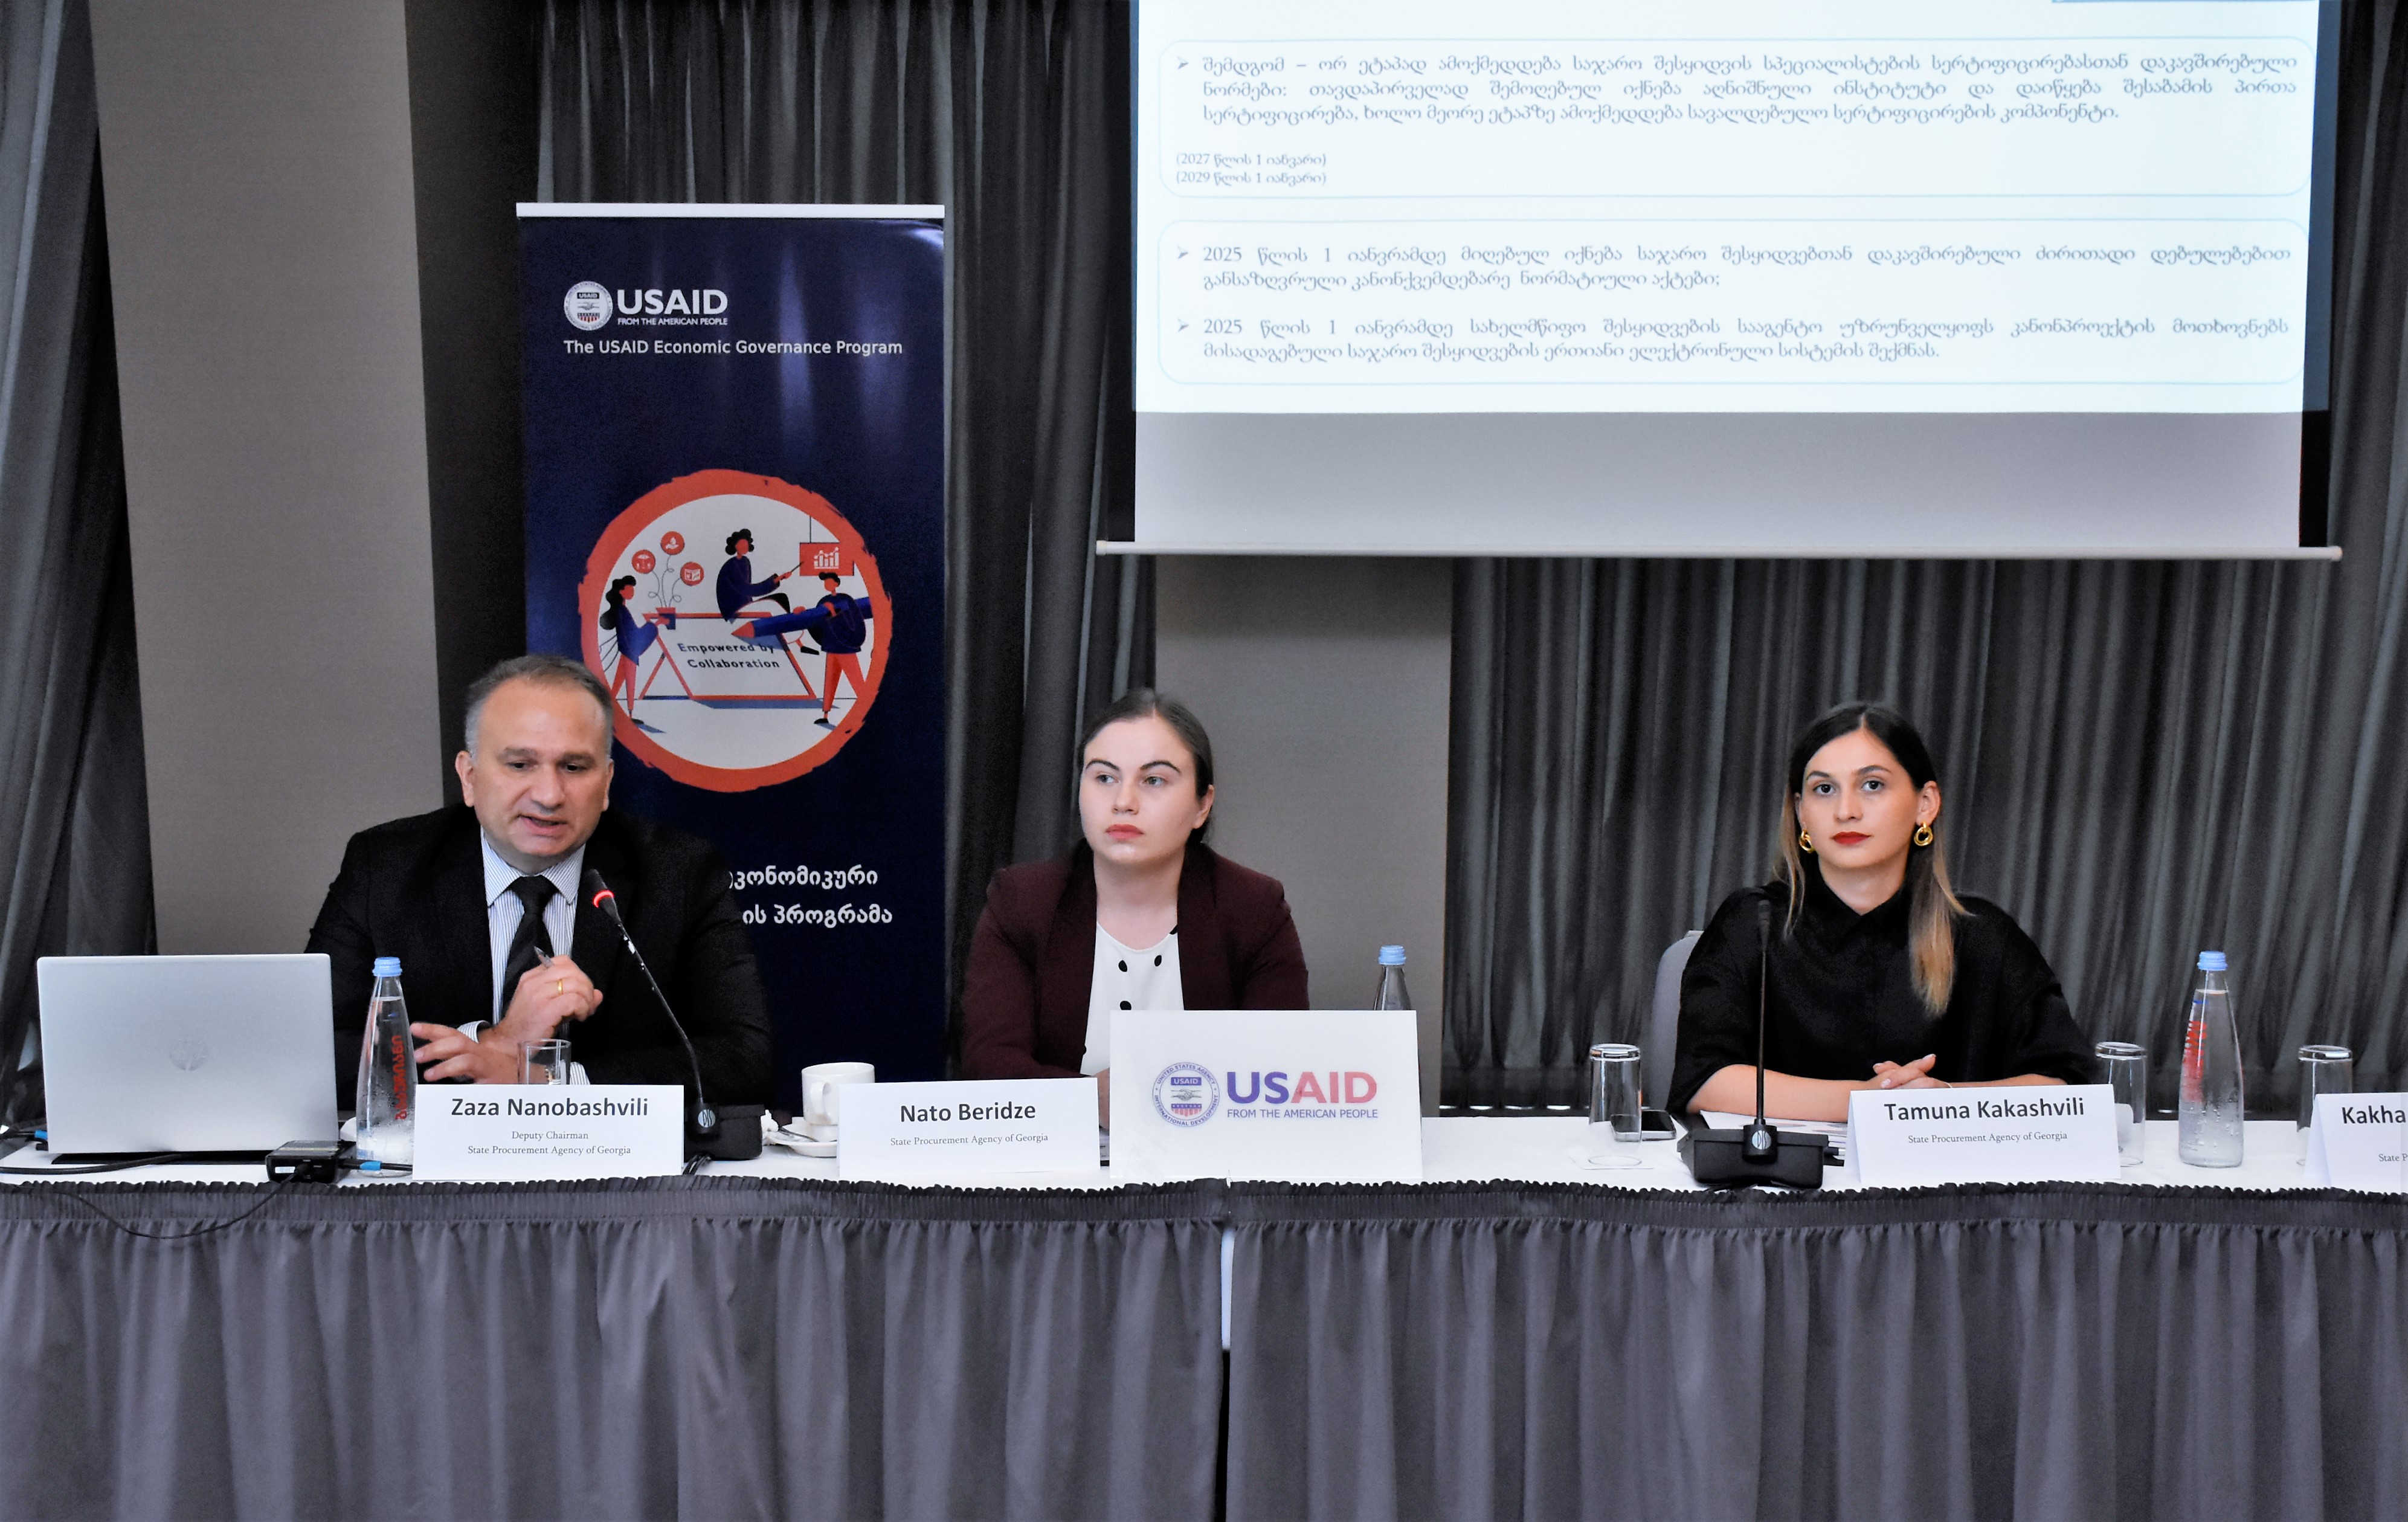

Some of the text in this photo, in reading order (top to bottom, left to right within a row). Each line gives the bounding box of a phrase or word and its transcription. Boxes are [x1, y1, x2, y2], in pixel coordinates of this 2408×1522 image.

[1202, 57, 1284, 77] შემდგომ
[1318, 56, 1347, 70] ორ
[1359, 56, 1427, 76] ეტაპად
[1573, 54, 1643, 76] საჯარო
[1653, 54, 1752, 76] შესყიდვის
[1203, 82, 1286, 102] ნორმები:
[1489, 80, 1602, 100] შემოღებულ
[1623, 80, 1682, 100] იქნება
[1703, 80, 1812, 100] აღნიშნული
[1833, 79, 1946, 100] ინსტიტუტი
[1968, 83, 1994, 99] და
[2016, 79, 2102, 99] დაიწყება
[2123, 77, 2213, 98] შესაბამის
[2235, 79, 2296, 94] პირთა
[1363, 105, 1421, 124] ხოლო
[1426, 104, 1484, 124] მეორე
[1489, 104, 1556, 124] ეტაპზე
[1214, 153, 1252, 169] წლის
[1257, 154, 1261, 166] 1
[1213, 172, 1252, 187] წლის
[1257, 172, 1261, 184] 1
[1203, 247, 1242, 262] 2025
[1257, 247, 1308, 266] წლის
[1325, 247, 1330, 262] 1
[1348, 247, 1446, 266] იანვრამდე
[1461, 245, 1550, 265] მიღებულ
[1564, 245, 1623, 265] იქნება
[1637, 245, 1707, 265] საჯარო
[2036, 245, 2136, 264] ძირითადი
[1652, 270, 1719, 290] აქტები;
[617, 289, 728, 315] USAID
[617, 317, 728, 326] FROM THE AMERICAN PEOPLE
[1204, 318, 1243, 334] 2025
[1260, 319, 1310, 339] წლის
[1330, 320, 1335, 335] 1
[1354, 319, 1453, 339] იანვრამდე
[1737, 318, 1823, 338] სააგენტო
[563, 340, 903, 357] The USAID Economic Governance Program
[1348, 343, 1417, 363] საჯარო
[1544, 342, 1624, 362] ერთიანი
[1779, 341, 1864, 362] სისტემის
[1868, 341, 1939, 362] შექმნას.
[678, 642, 774, 654] Empowered by
[687, 659, 779, 668] Collaboration
[729, 864, 878, 890] კონომიკური
[742, 903, 893, 929] ის პროგრამა
[1157, 1068, 1174, 1084] UNITED
[1197, 1067, 1215, 1085] AGENCY
[1226, 1071, 1377, 1104] USAID
[451, 1097, 648, 1116] Zaza Nanobashvili
[901, 1101, 1035, 1123] Nato Beridze
[1154, 1094, 1218, 1126] INTERNATIONAL DEVELOPMENT
[1227, 1109, 1378, 1118] FROM THE AMERICAN PEOPLE
[1884, 1097, 2084, 1121] Tamuna Kakashvili
[2342, 1104, 2406, 1124] Kakha
[512, 1130, 588, 1142] Deputy Chairman
[914, 1137, 968, 1145] Procurement
[971, 1135, 1002, 1146] Agency
[1005, 1133, 1014, 1142] of
[1016, 1133, 1048, 1143] Georgia
[1931, 1134, 1986, 1143] Procurement
[1989, 1133, 2021, 1144] Agency
[2023, 1132, 2032, 1140] of
[2033, 1132, 2067, 1141] Georgia
[468, 1146, 631, 1156] State Procurement Agency of Georgia
[2378, 1153, 2400, 1162] State
